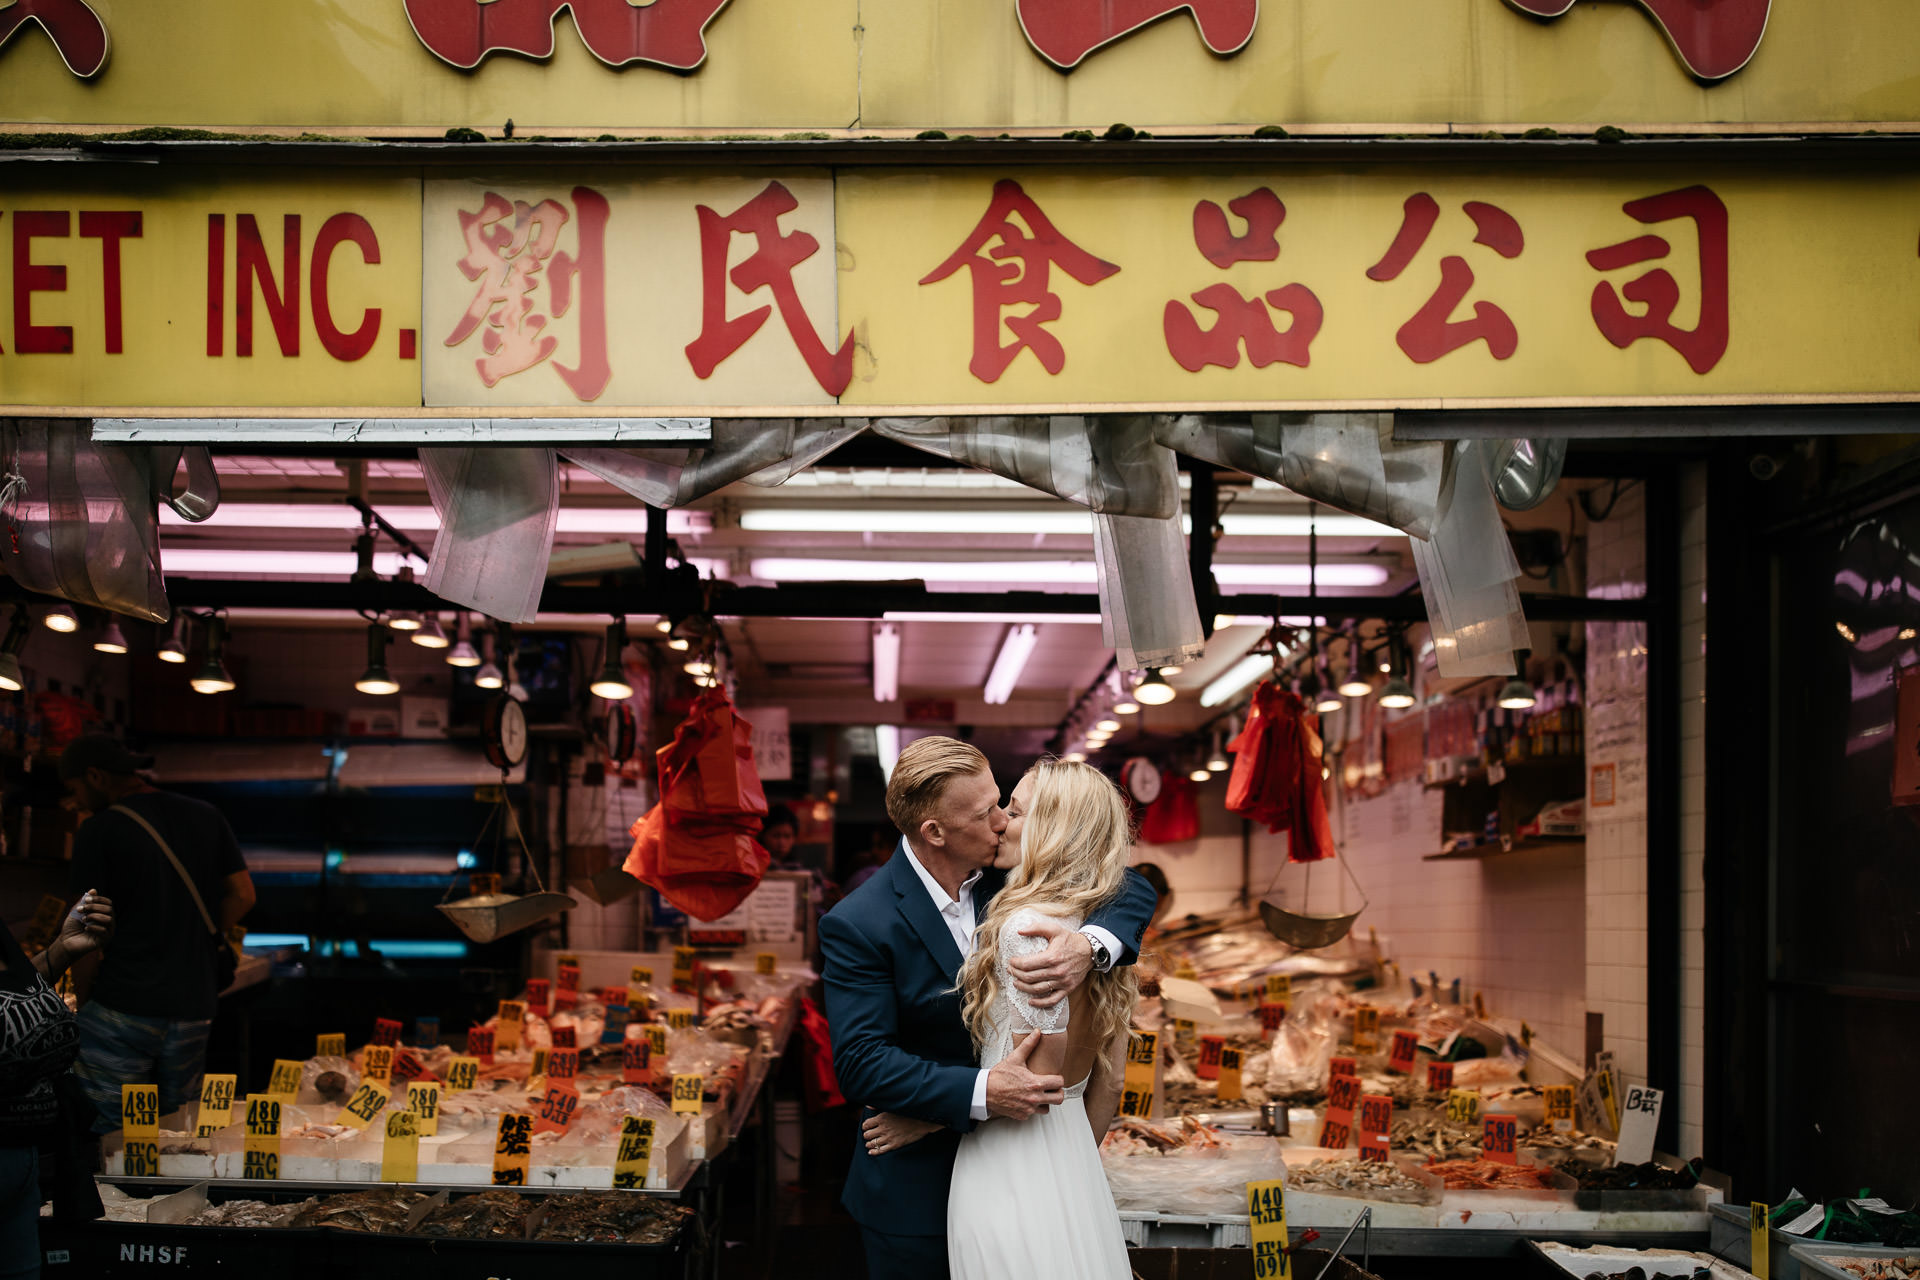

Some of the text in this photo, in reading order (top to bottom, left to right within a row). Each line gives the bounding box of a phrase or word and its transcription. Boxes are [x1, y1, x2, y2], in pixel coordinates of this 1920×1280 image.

[0, 211, 415, 361] ET INC.
[120, 1243, 188, 1264] NHSF
